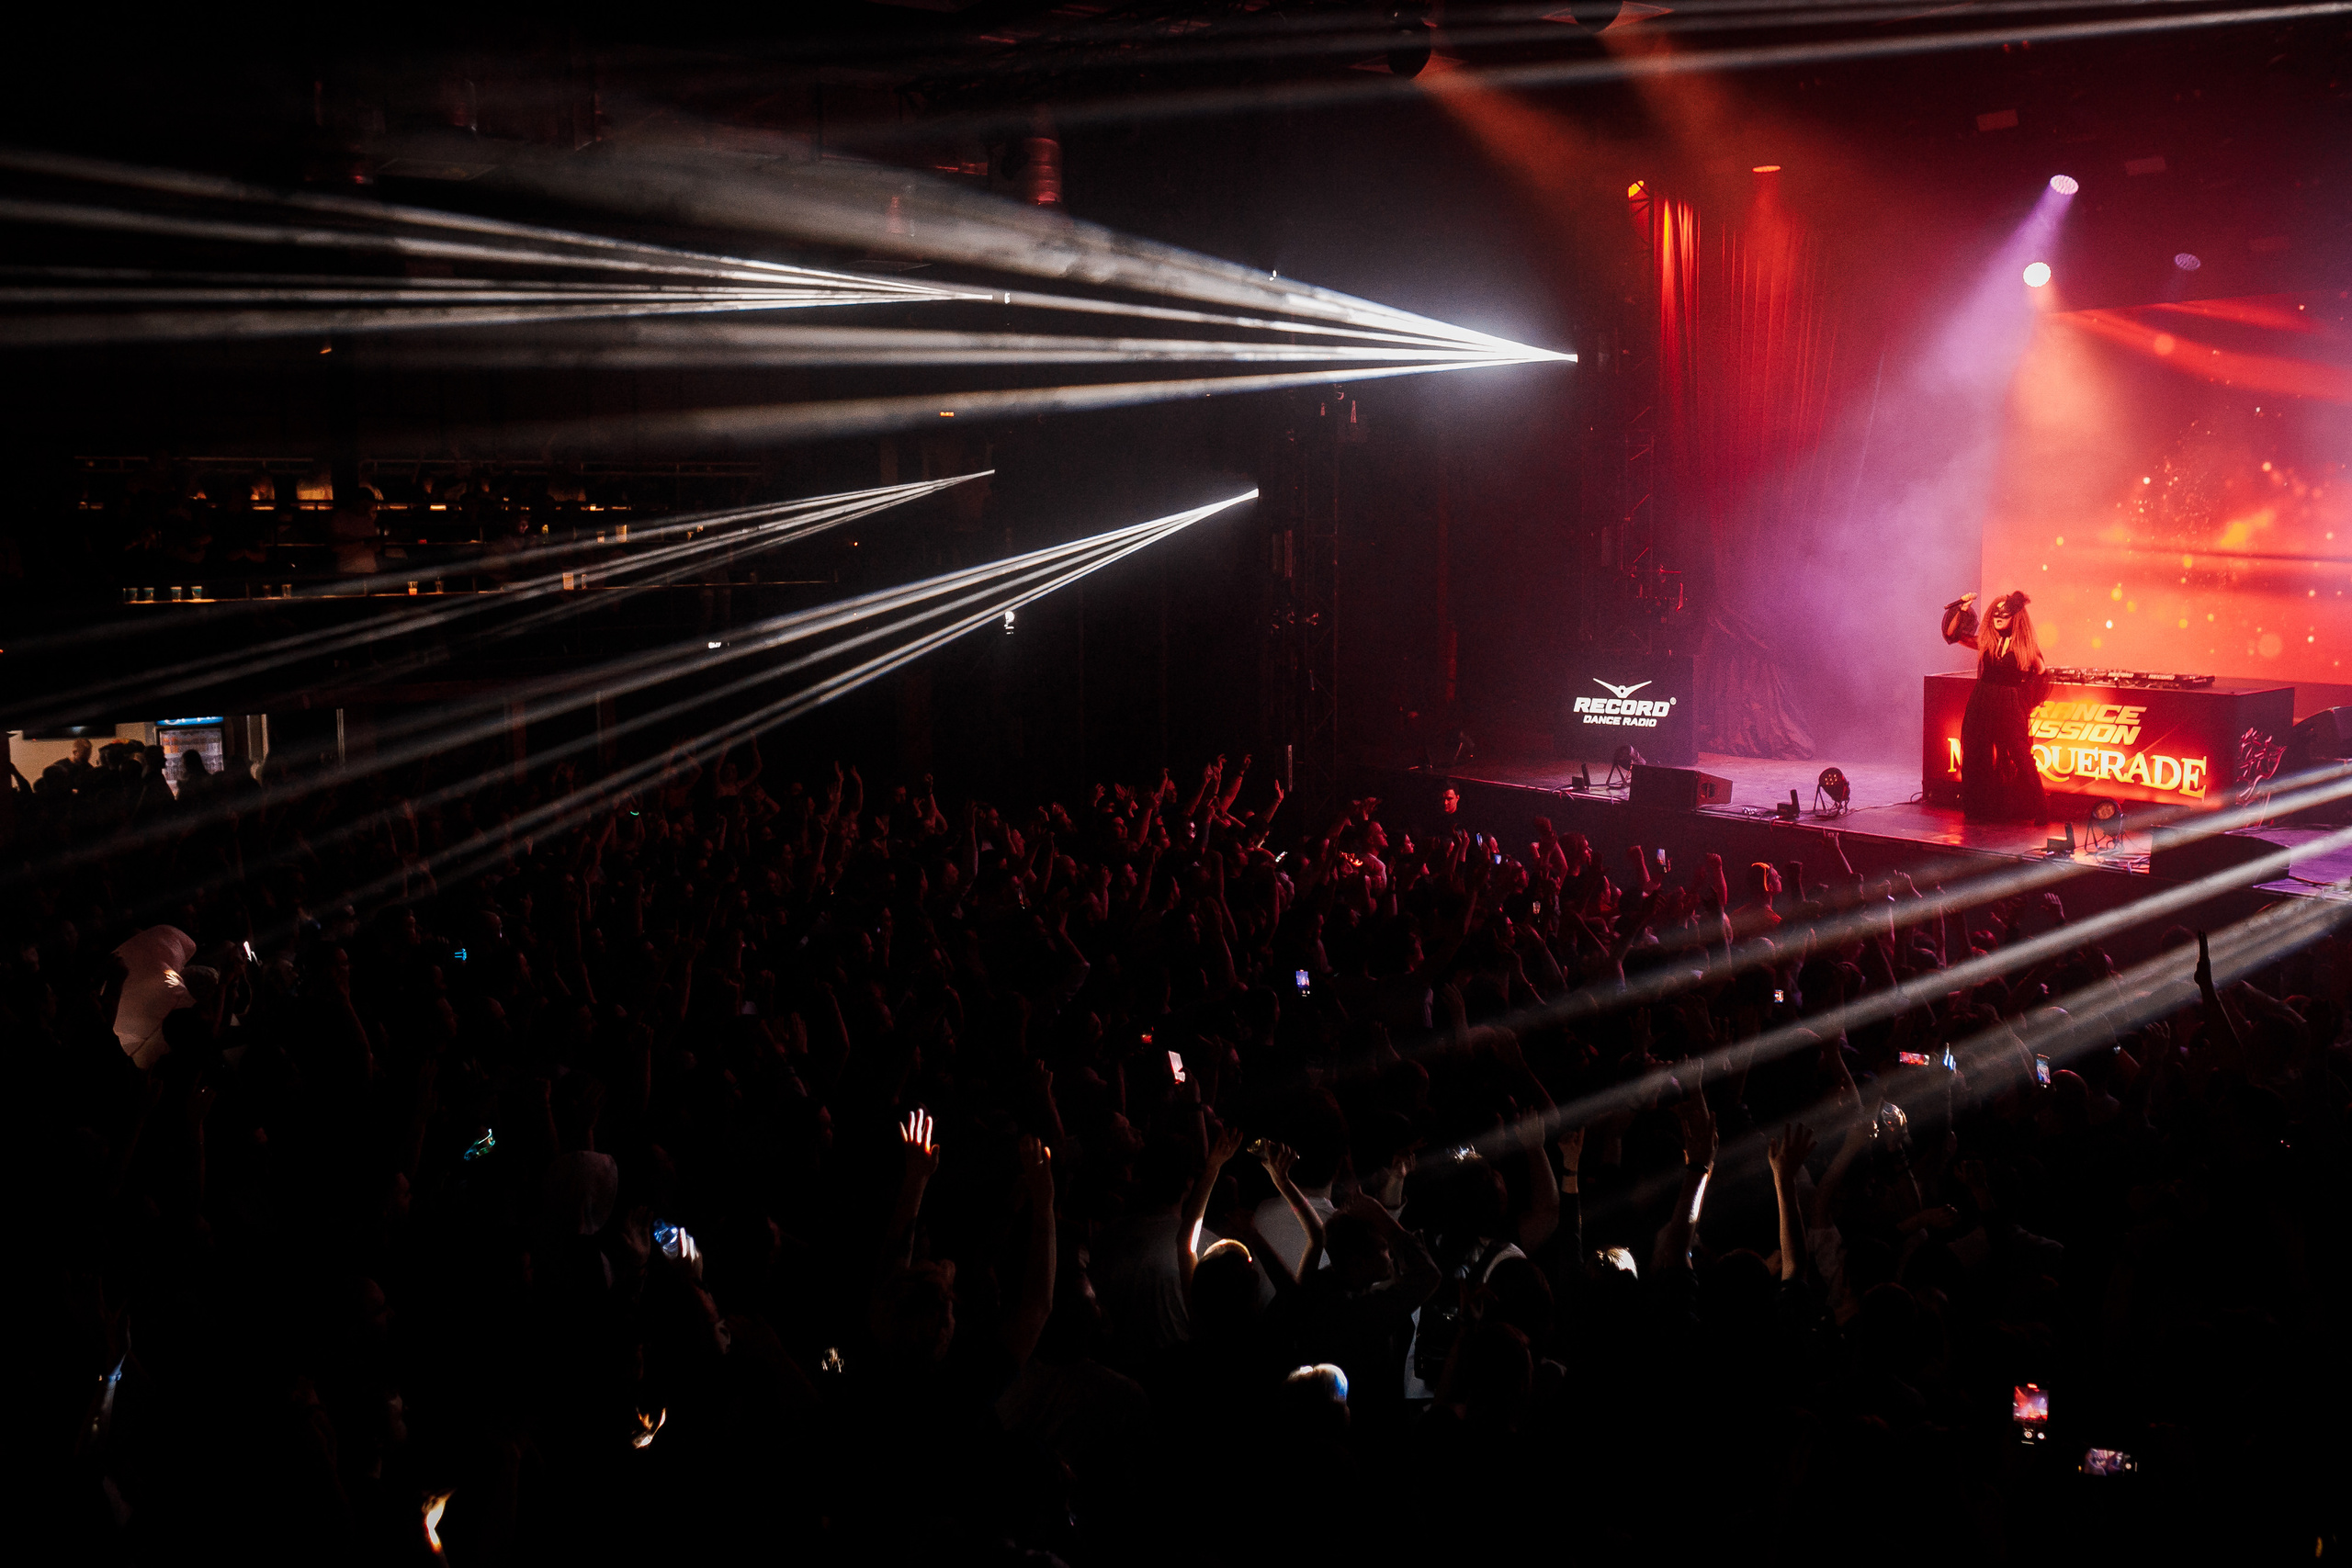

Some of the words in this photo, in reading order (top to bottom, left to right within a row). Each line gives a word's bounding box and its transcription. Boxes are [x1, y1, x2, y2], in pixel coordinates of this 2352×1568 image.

[1583, 715, 1622, 726] DANCE
[1623, 716, 1657, 728] RADIO
[2030, 700, 2147, 726] RANCE
[2028, 718, 2142, 745] ISSION
[1948, 738, 2206, 801] QUERADE
